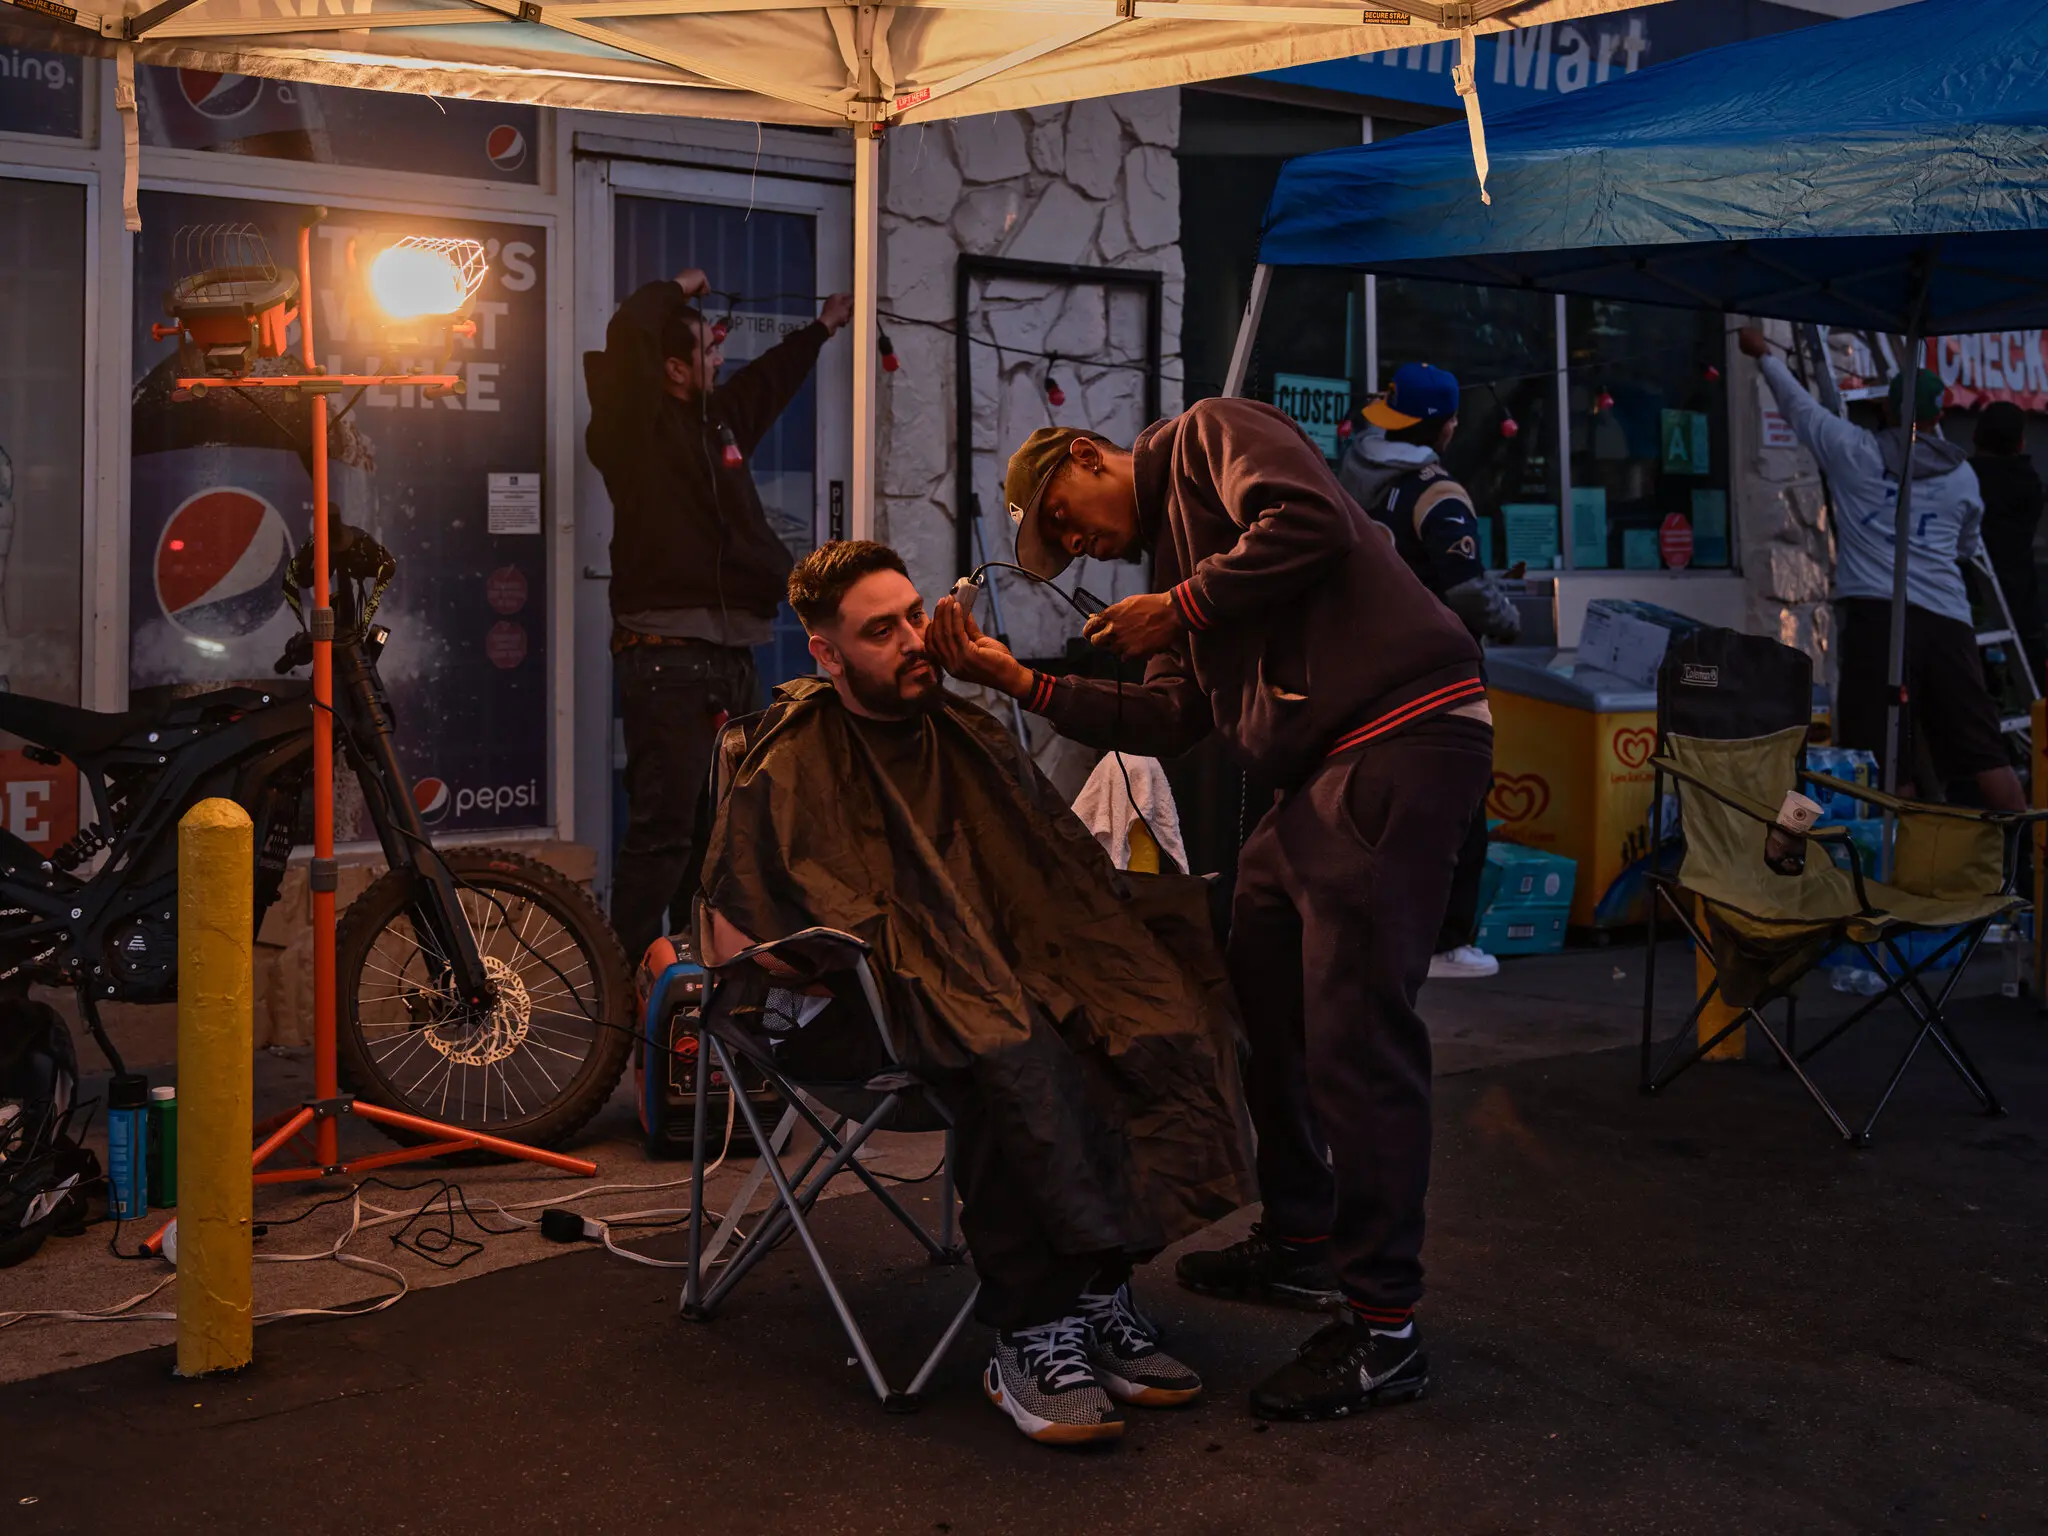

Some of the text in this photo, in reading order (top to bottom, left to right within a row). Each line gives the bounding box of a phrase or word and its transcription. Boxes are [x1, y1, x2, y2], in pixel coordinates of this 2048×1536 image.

[49, 3, 75, 16] STRAP
[1365, 11, 1409, 20] SECURE STRAP
[1493, 18, 1646, 94] Mart
[898, 89, 928, 106] LIFT HERE
[317, 225, 536, 292] T'S
[746, 316, 775, 334] TIER
[1937, 329, 2048, 393] CHECK
[366, 356, 500, 412] LIKE
[1279, 385, 1345, 425] CLOSED
[1668, 425, 1689, 461] A
[1685, 666, 1710, 681] Coleman
[456, 778, 537, 817] pepsi
